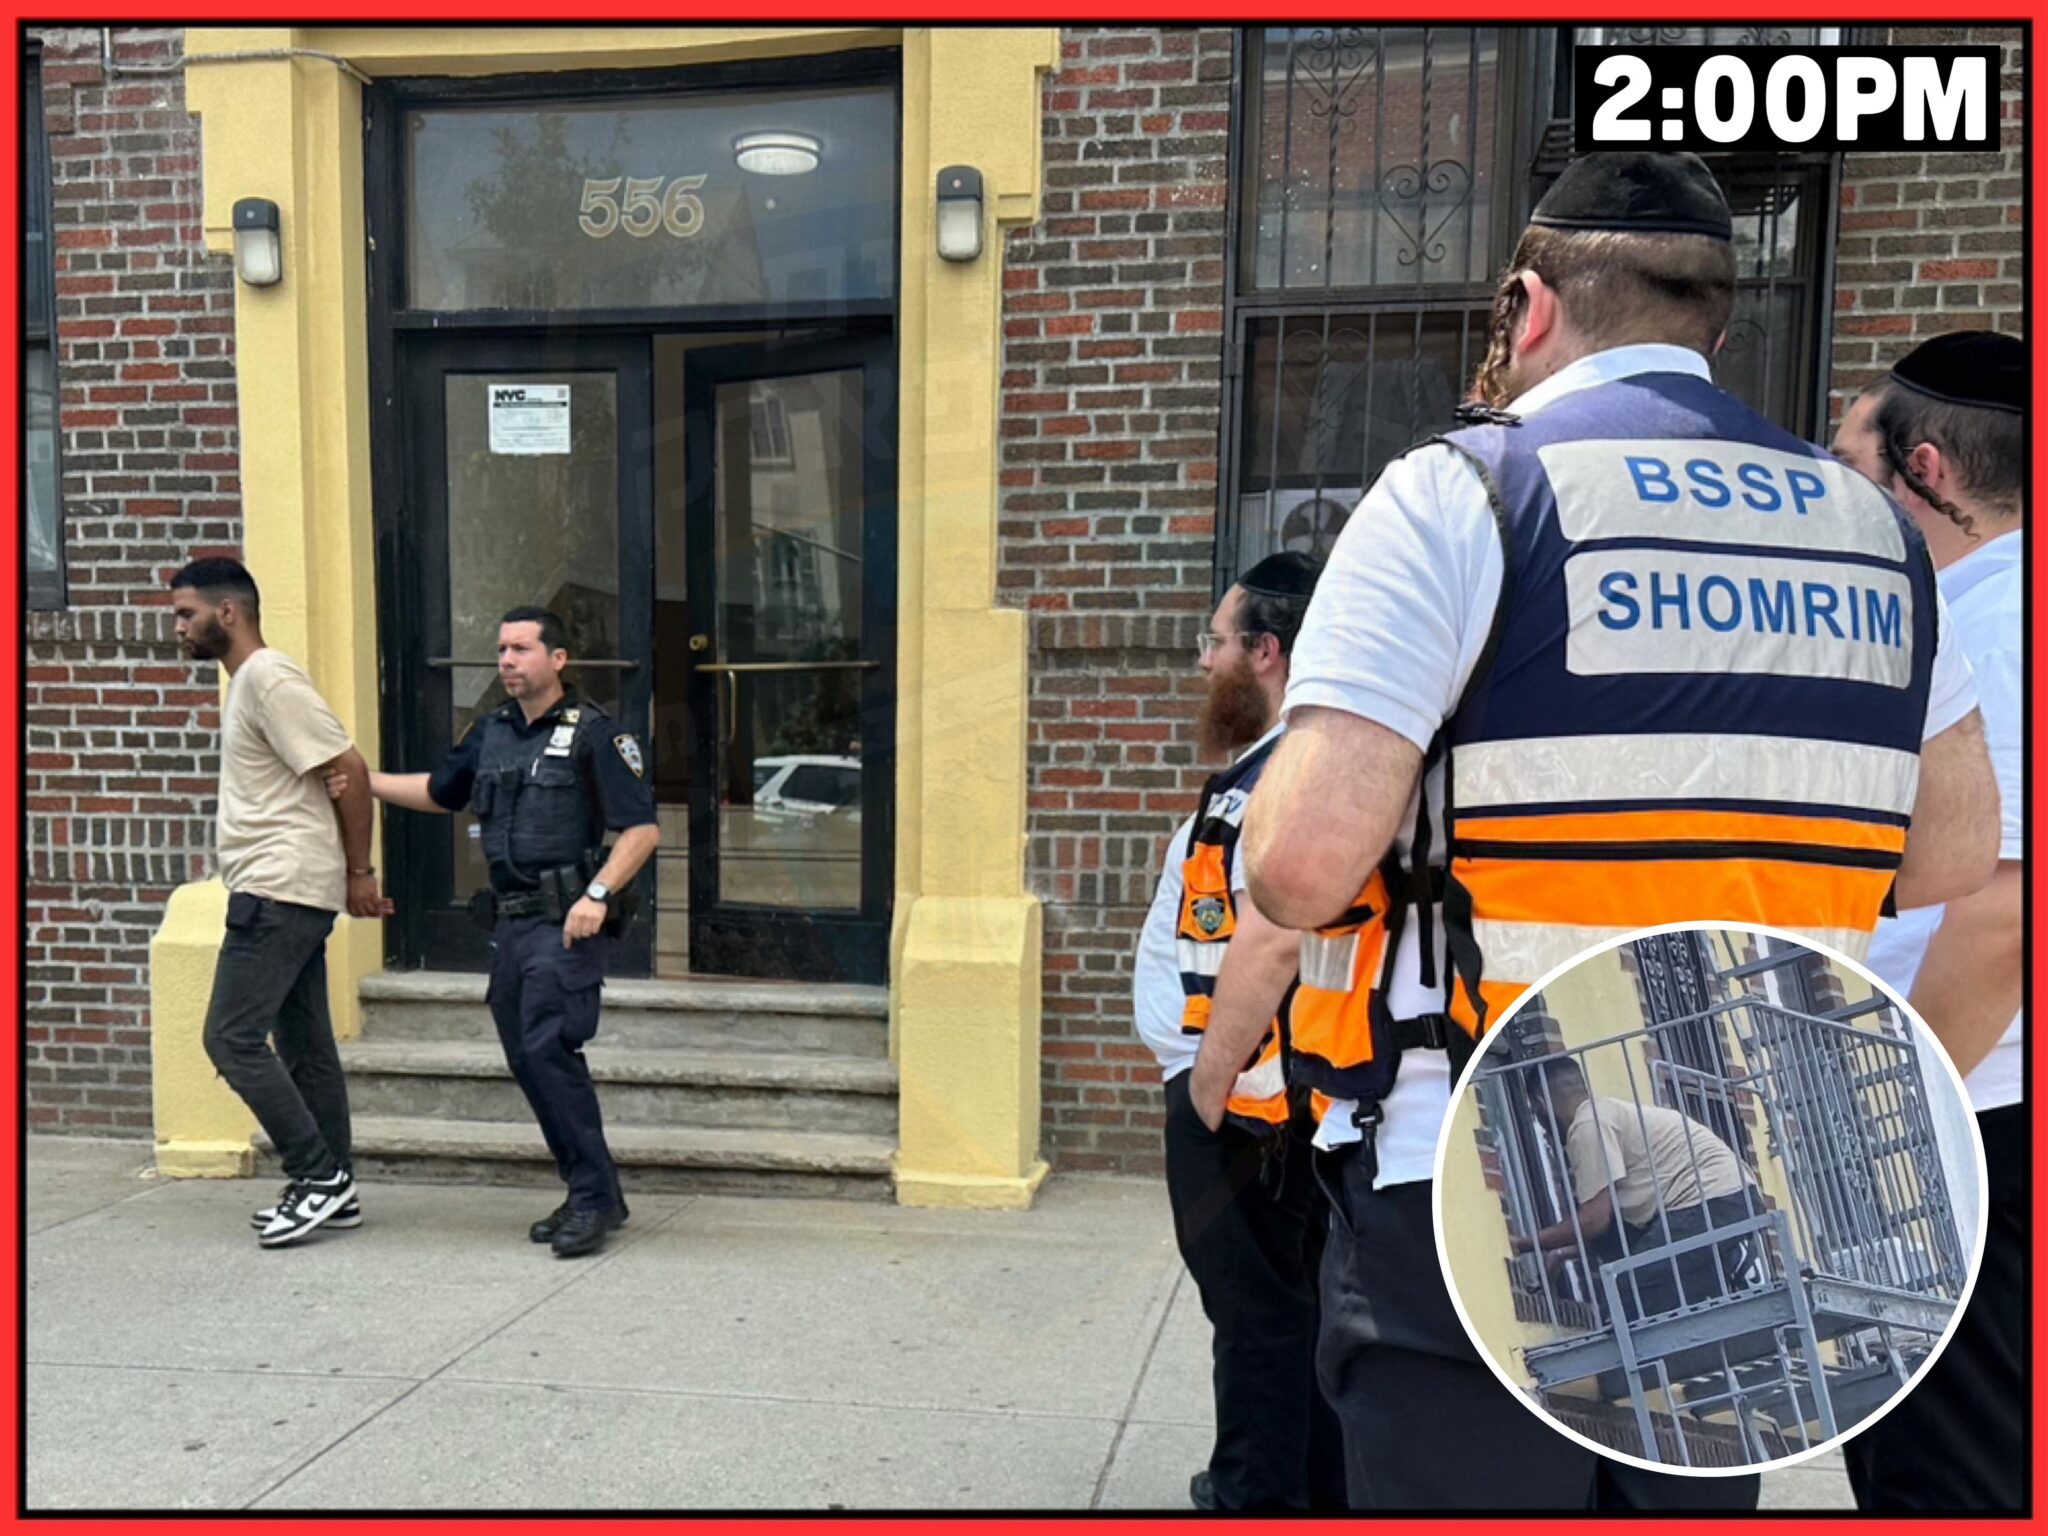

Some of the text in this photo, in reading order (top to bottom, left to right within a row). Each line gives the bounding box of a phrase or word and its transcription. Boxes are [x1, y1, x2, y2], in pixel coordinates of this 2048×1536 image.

[578, 173, 708, 238] 556
[494, 389, 526, 401] NYC
[1625, 456, 1826, 515] BSSP
[1598, 571, 1903, 648] SHOMRIM
